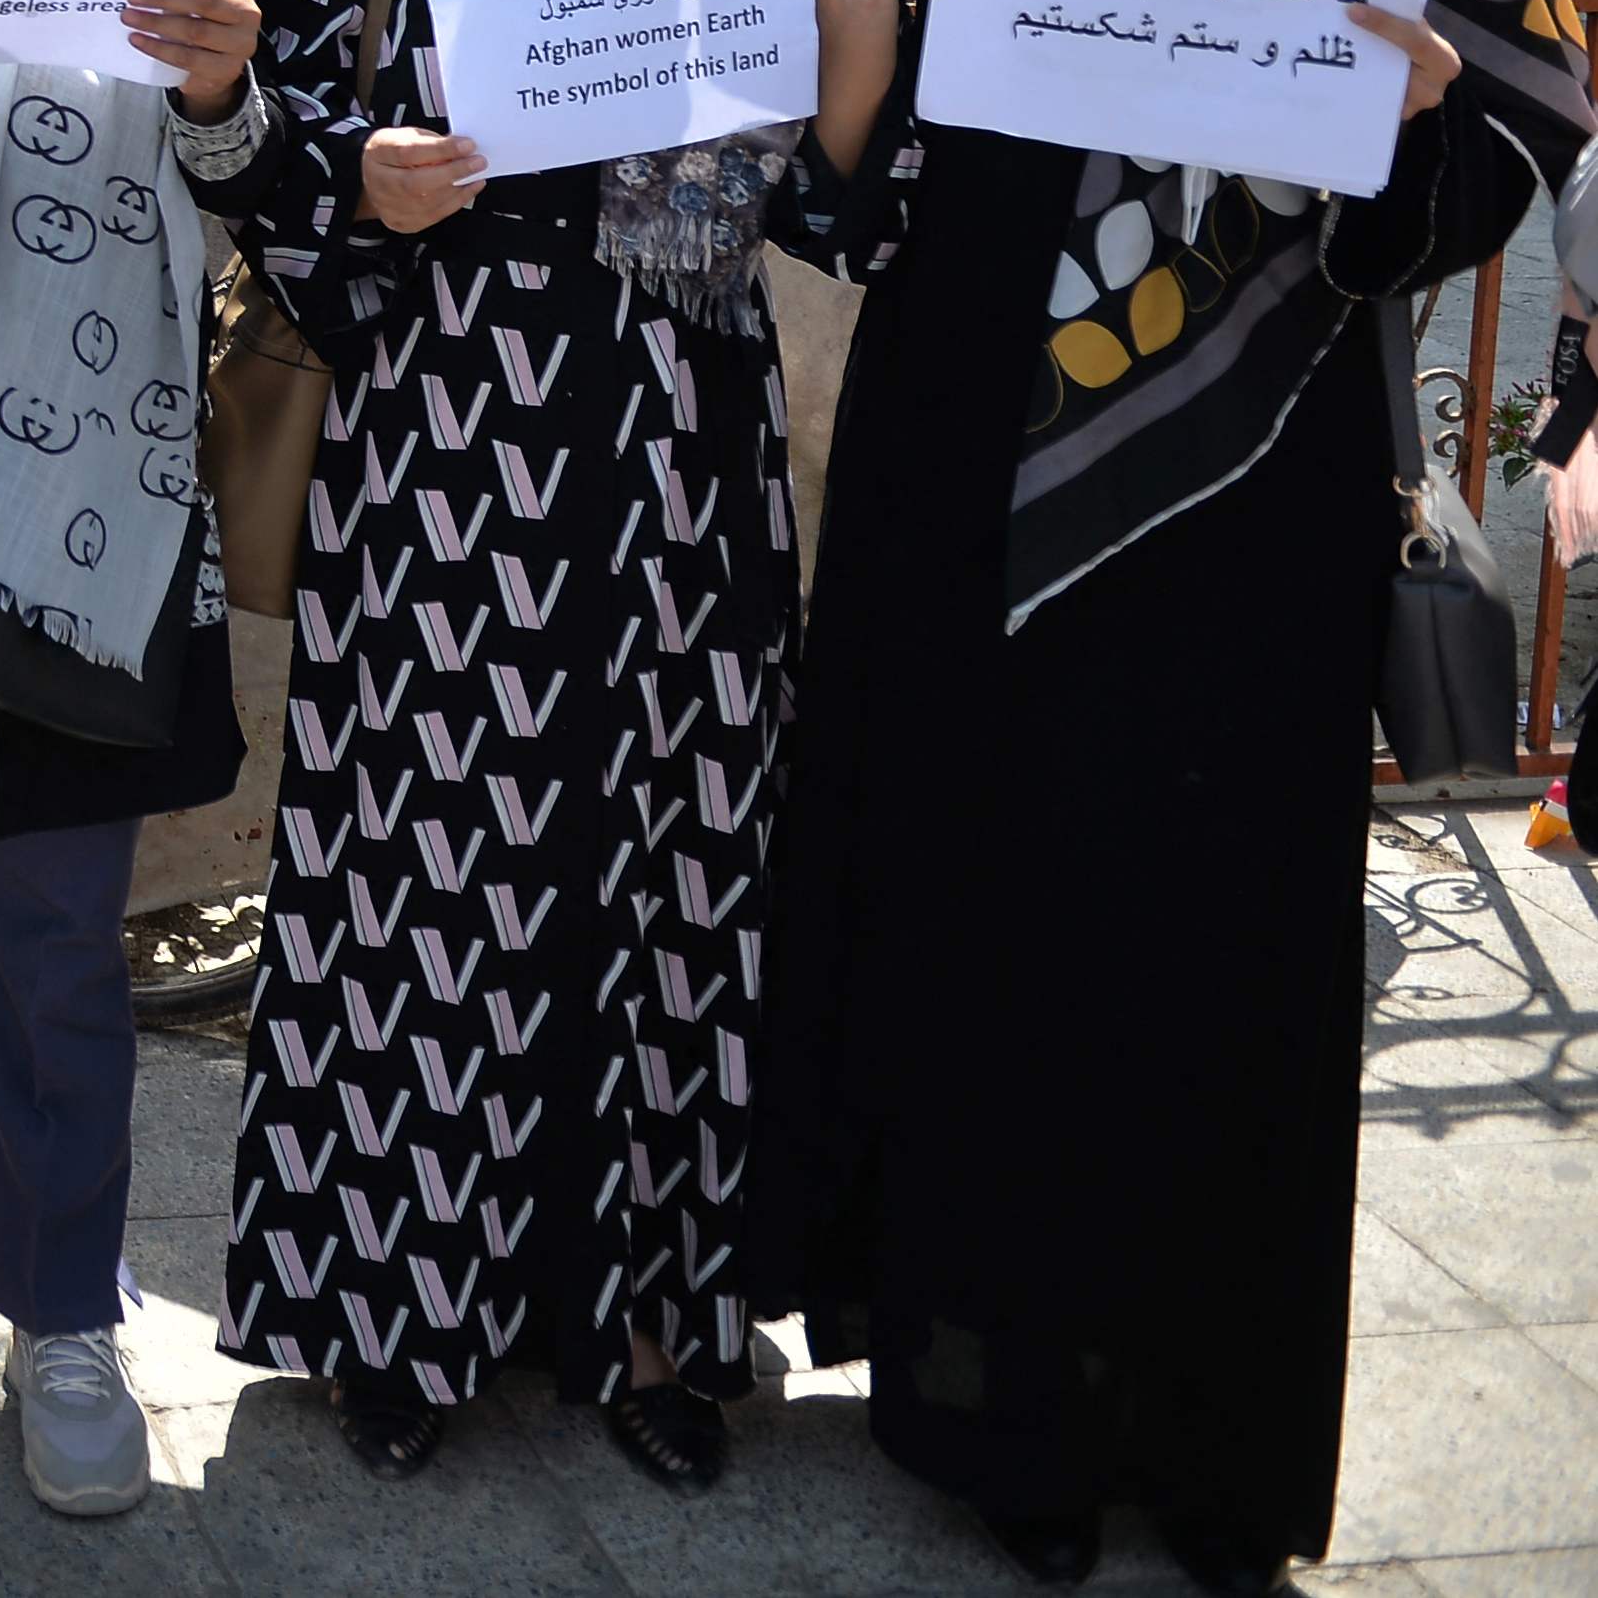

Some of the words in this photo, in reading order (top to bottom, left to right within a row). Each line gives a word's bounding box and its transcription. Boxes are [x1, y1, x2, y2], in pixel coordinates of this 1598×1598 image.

[525, 36, 610, 66] Afghan
[614, 20, 701, 50] women
[705, 4, 765, 34] Earth
[1012, 4, 1157, 45] شکستیم
[1169, 22, 1240, 62] ستم
[1251, 41, 1279, 68] و
[1291, 34, 1357, 77] ظلم
[516, 86, 561, 110] The
[566, 66, 650, 106] symbol
[655, 60, 680, 86] of
[681, 54, 727, 81] this
[731, 43, 779, 73] land
